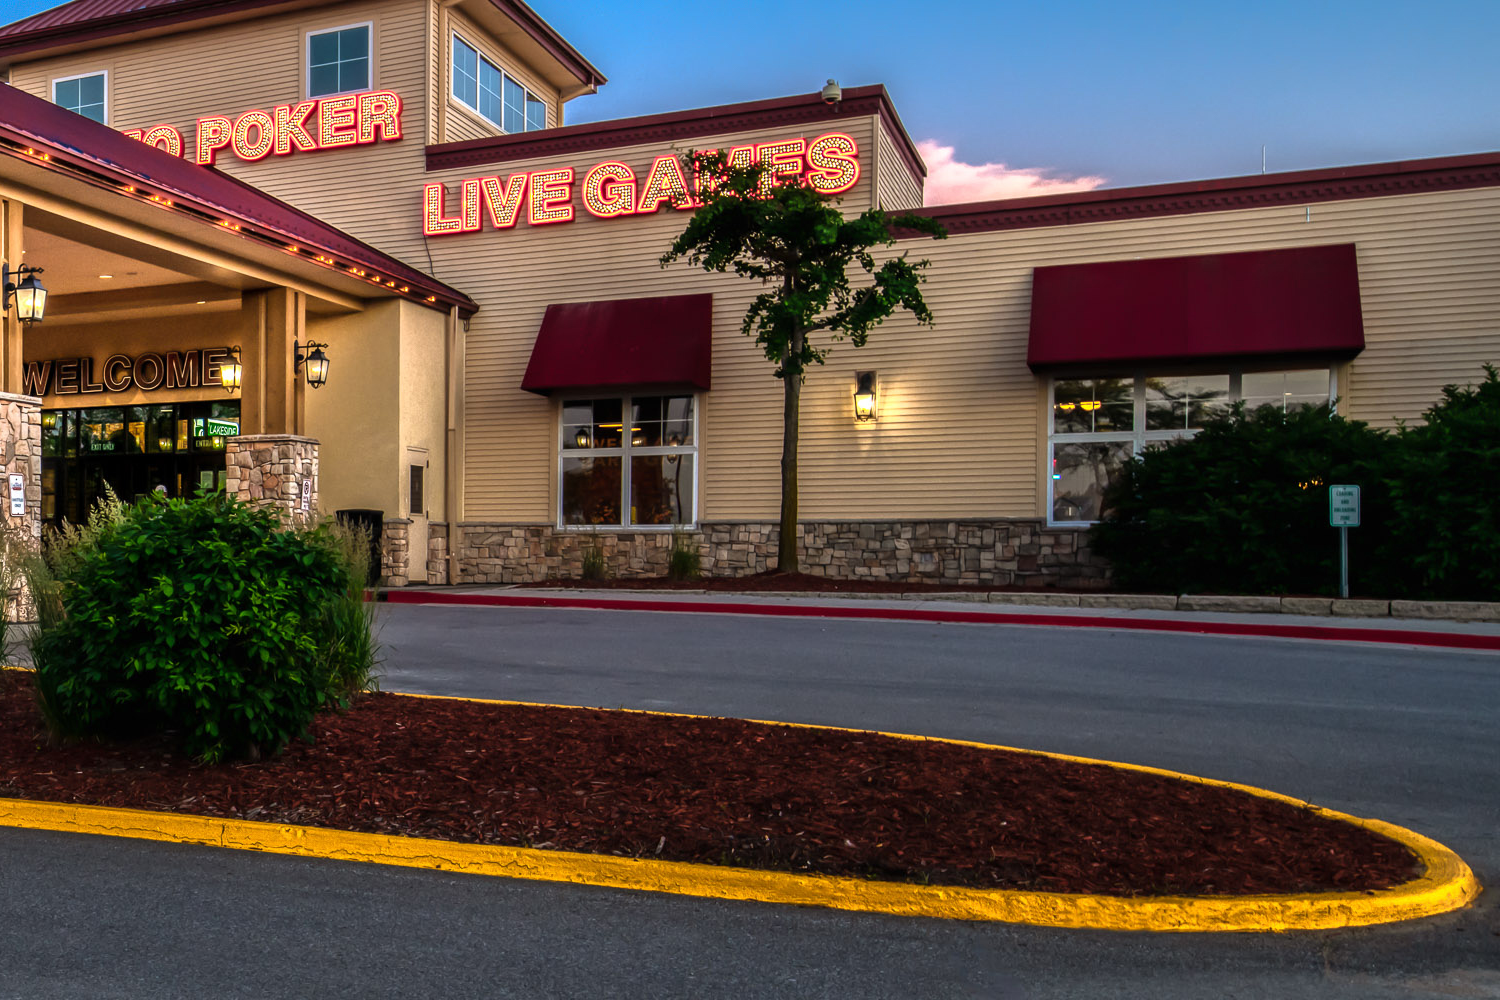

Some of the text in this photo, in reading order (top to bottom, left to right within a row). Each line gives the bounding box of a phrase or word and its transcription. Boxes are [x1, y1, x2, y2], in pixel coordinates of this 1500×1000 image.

[121, 89, 403, 166] O POKER
[423, 167, 574, 236] LIVE
[22, 347, 229, 396] WELCOME
[91, 443, 102, 451] EXIT
[209, 424, 237, 436] LAKESIDE
